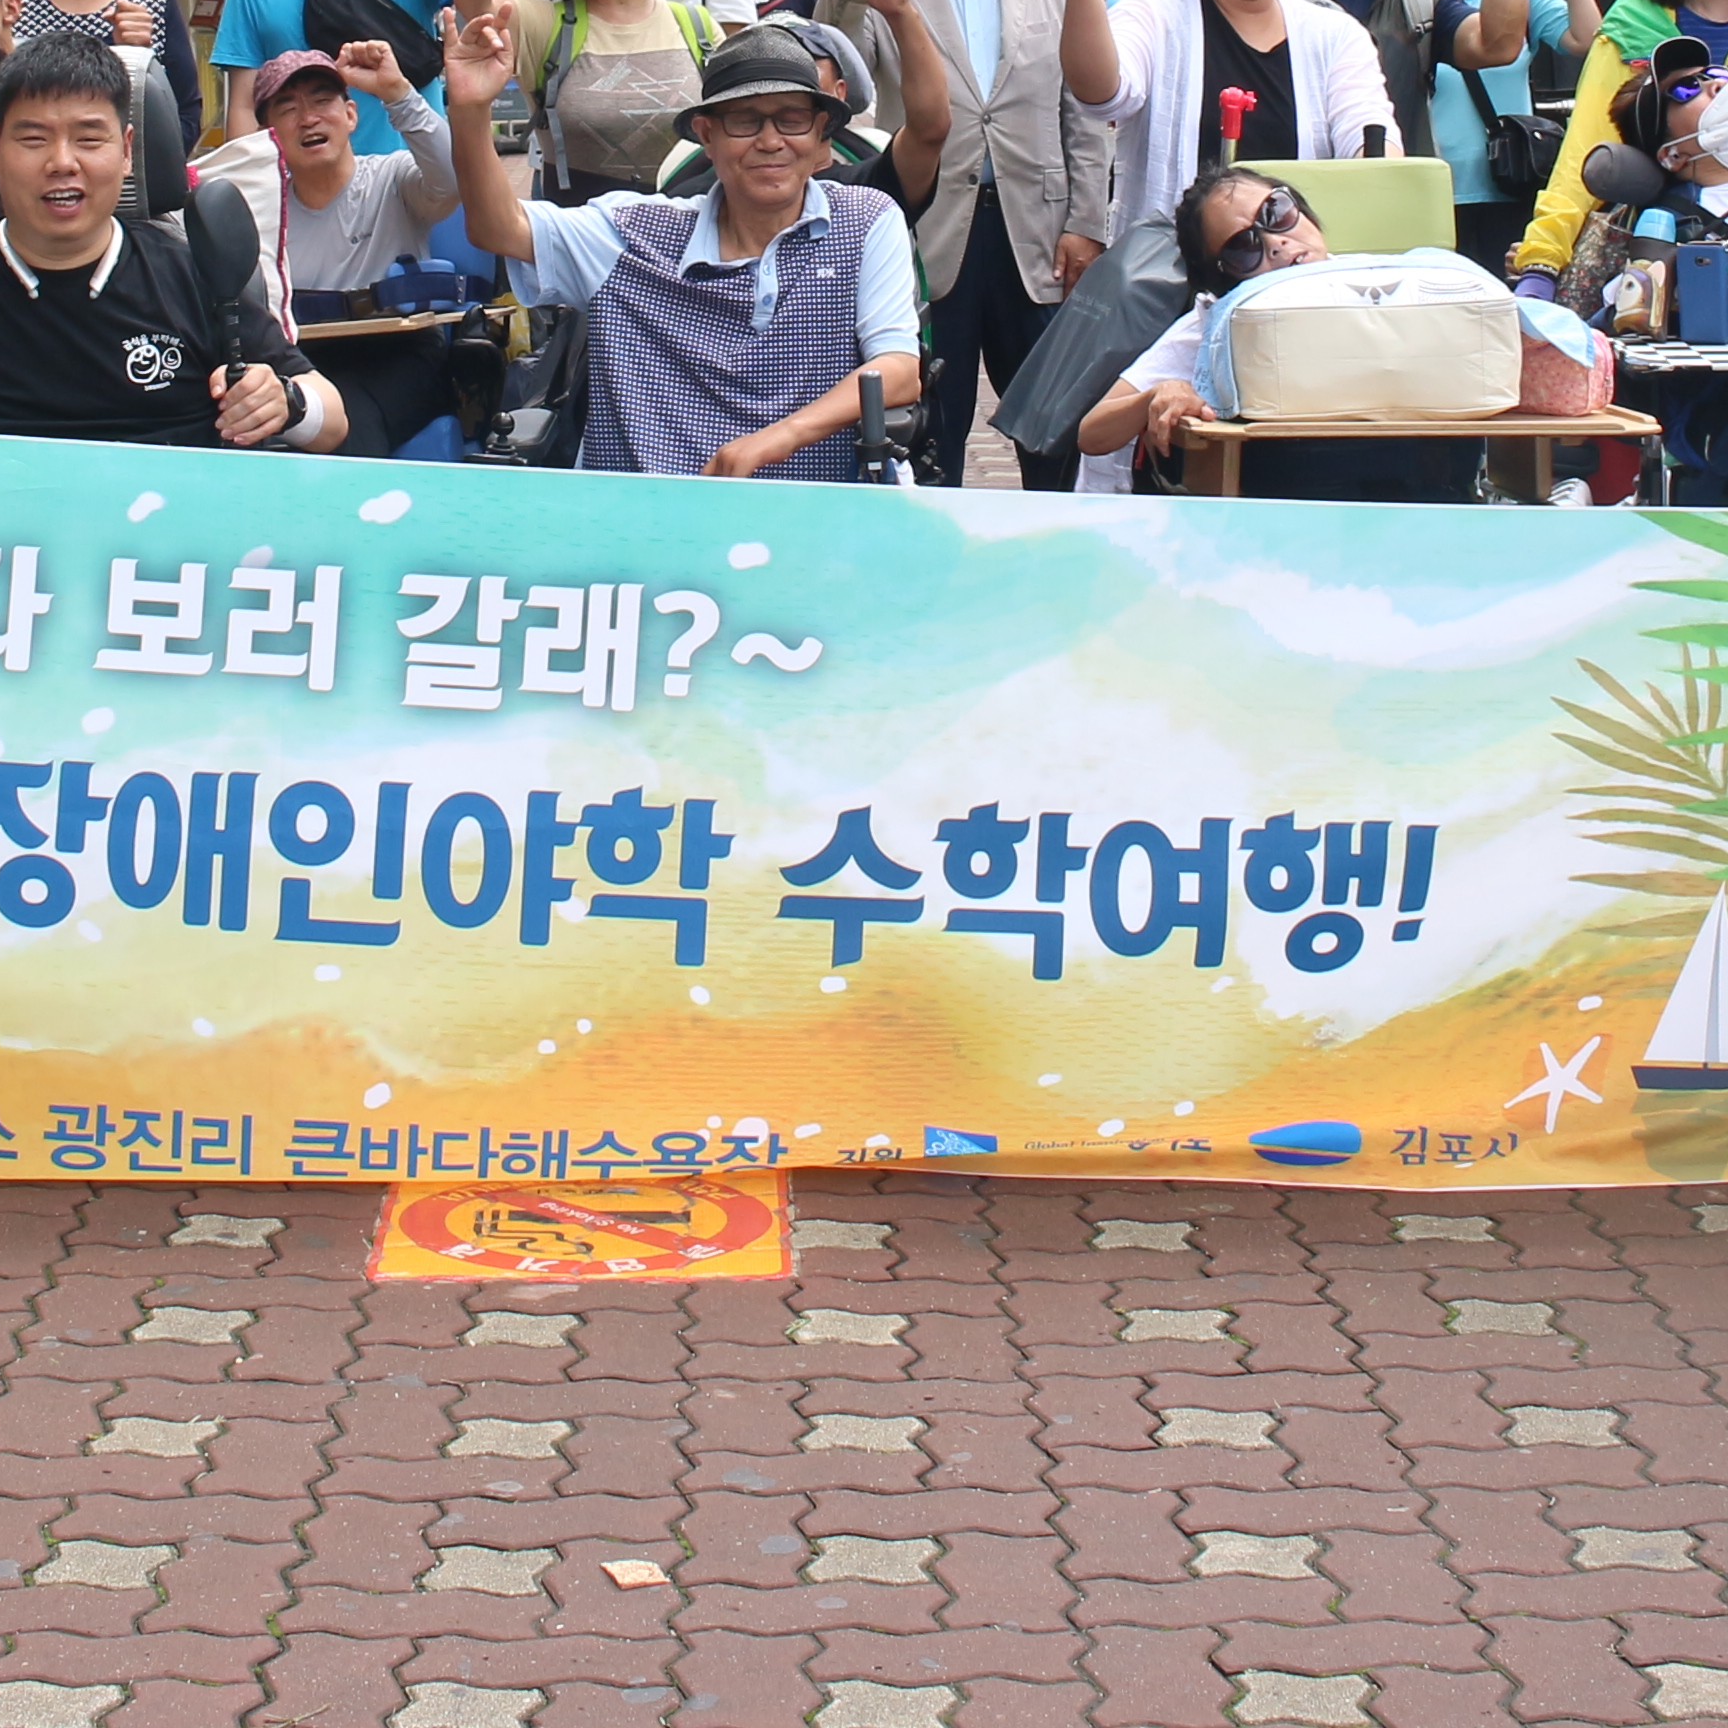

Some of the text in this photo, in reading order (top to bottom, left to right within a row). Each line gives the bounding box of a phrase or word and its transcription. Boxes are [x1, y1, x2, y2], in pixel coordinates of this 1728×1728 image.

[93, 559, 345, 692] 보러
[392, 572, 826, 714] 갈래?~
[774, 801, 1443, 981] 수학여행!
[43, 1103, 254, 1176] 광진리
